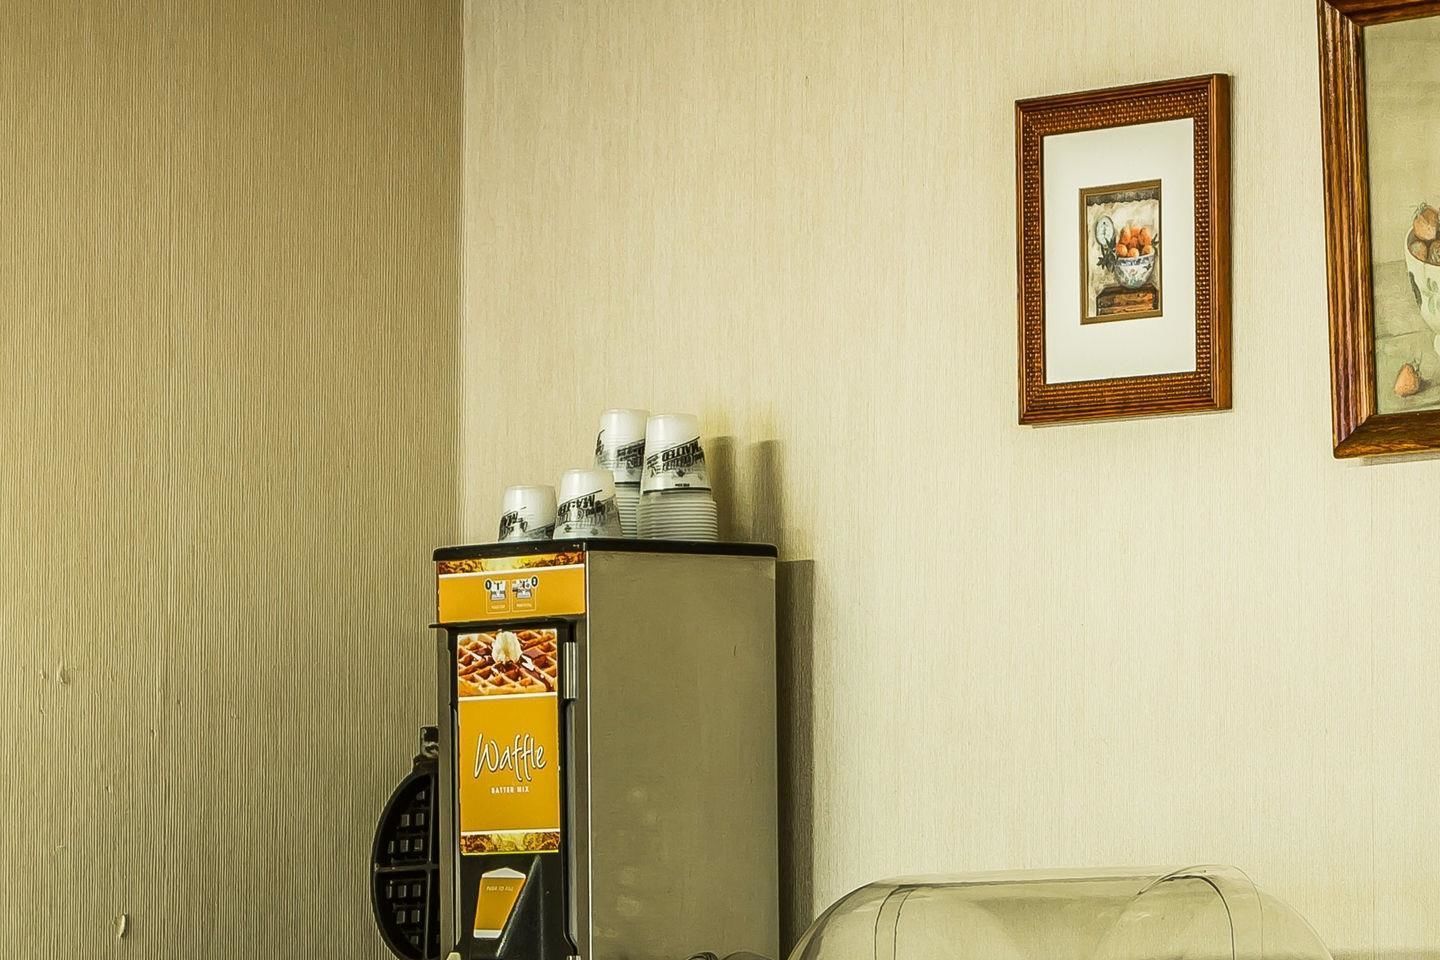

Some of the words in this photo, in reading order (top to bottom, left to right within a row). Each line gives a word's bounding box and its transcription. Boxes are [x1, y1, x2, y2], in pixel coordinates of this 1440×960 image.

[474, 733, 546, 782] Waffle
[491, 786, 514, 794] BATTER
[516, 785, 530, 793] MIX
